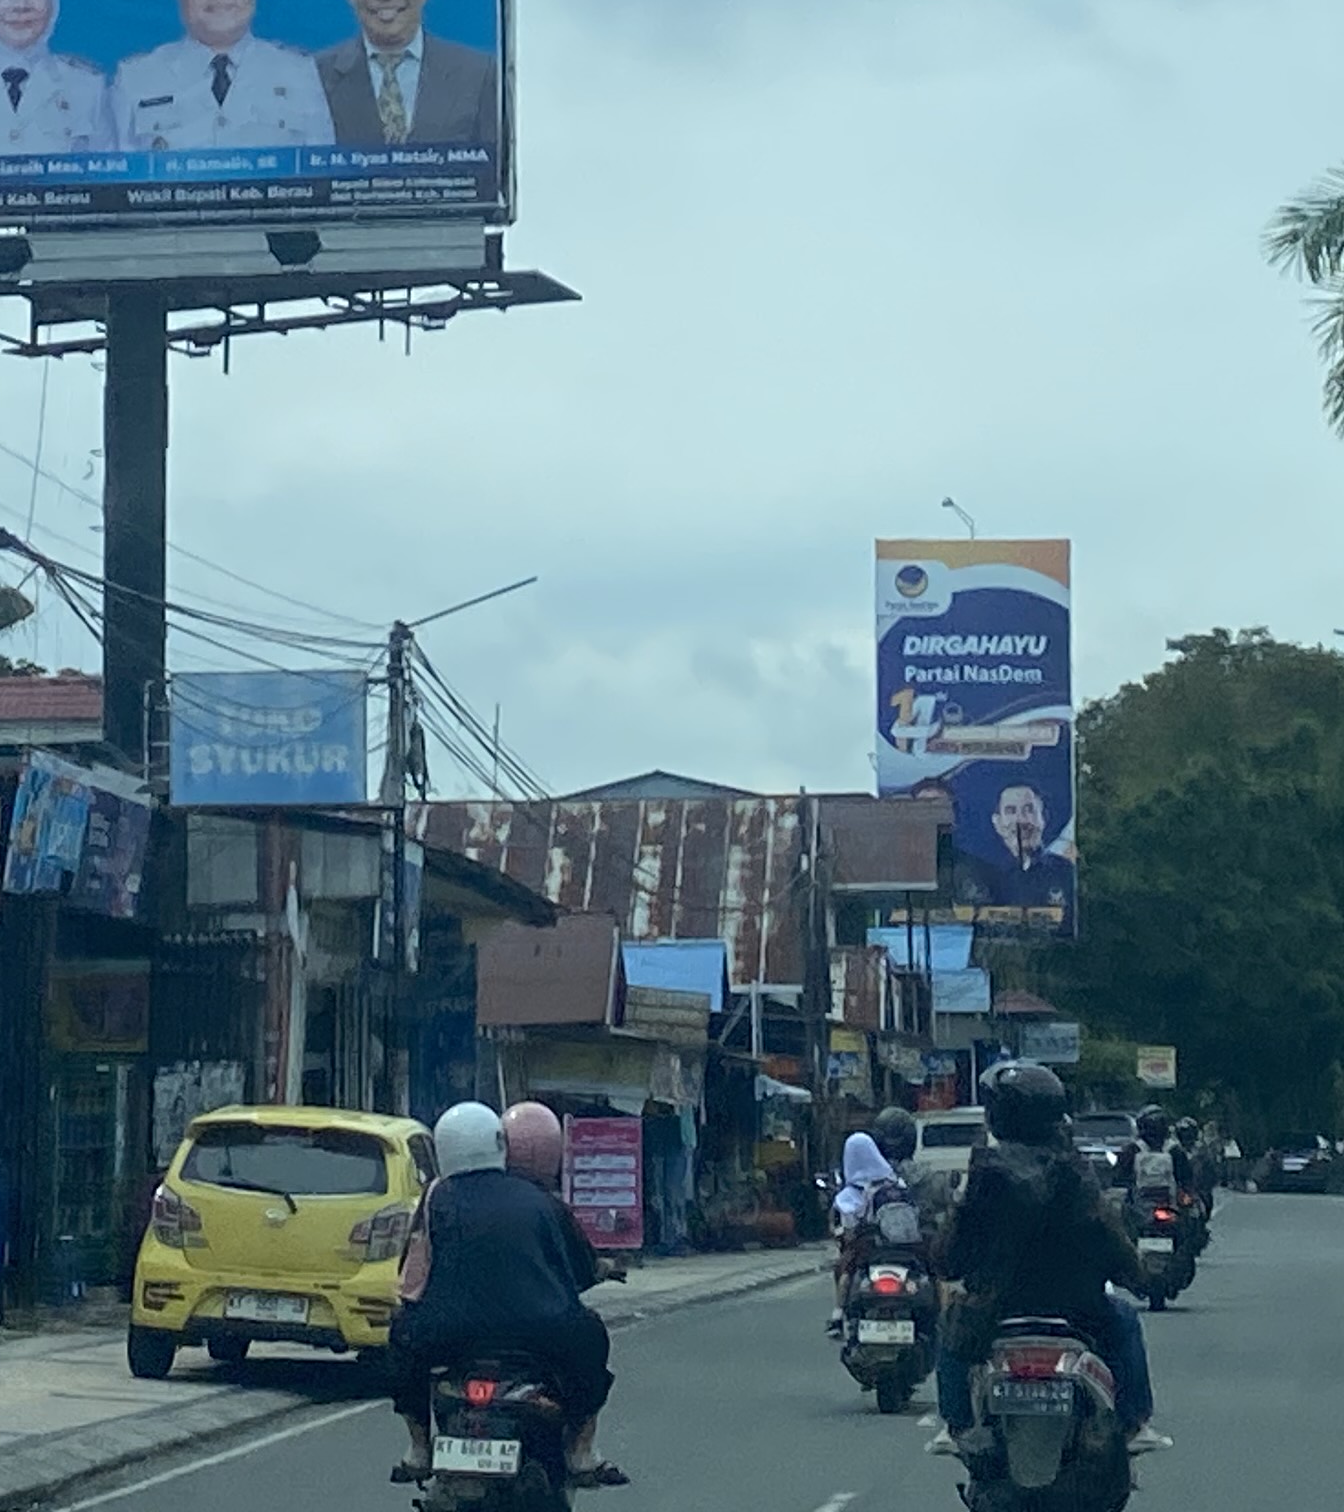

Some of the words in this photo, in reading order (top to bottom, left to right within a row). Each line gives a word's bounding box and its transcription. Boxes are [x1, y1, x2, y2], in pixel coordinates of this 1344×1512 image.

[447, 148, 489, 162] MMA
[903, 636, 1047, 656] DIRGAHAYU
[905, 665, 959, 683] Partai
[964, 666, 1042, 683] NasDem
[189, 744, 349, 775] SYUKUR
